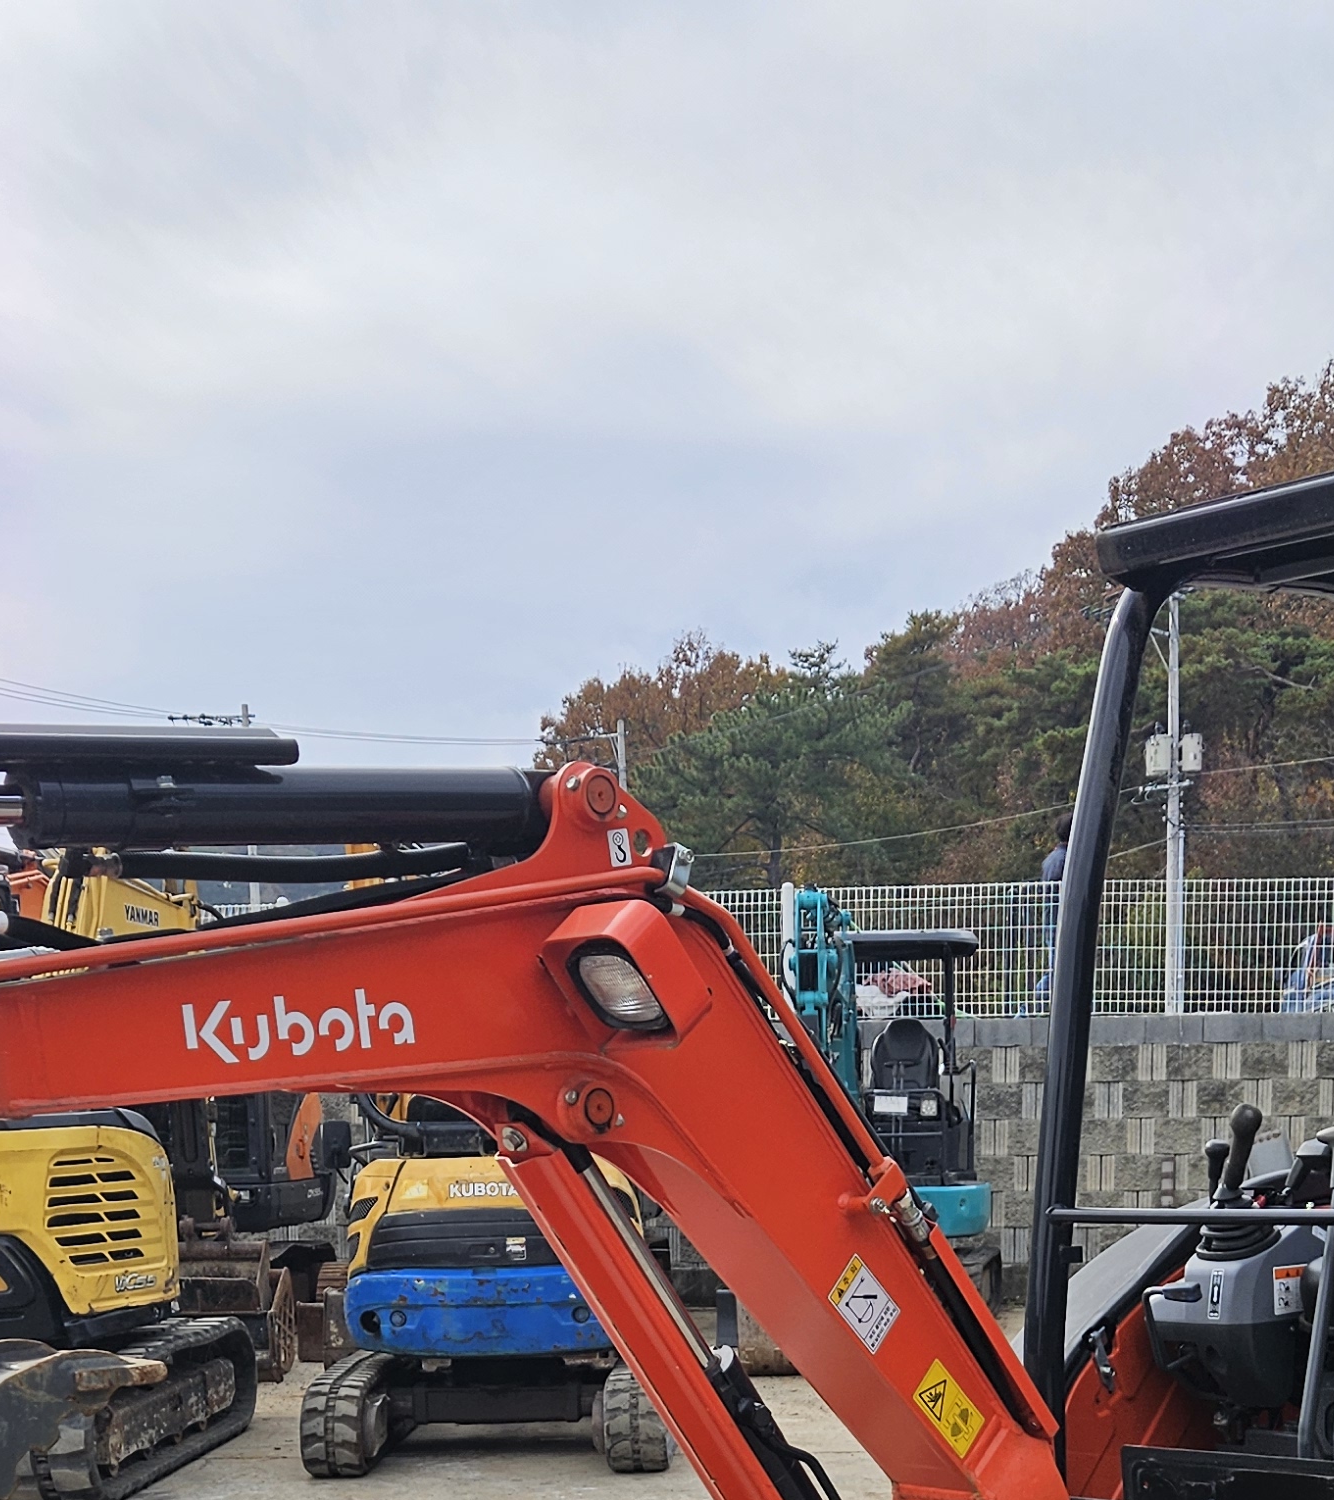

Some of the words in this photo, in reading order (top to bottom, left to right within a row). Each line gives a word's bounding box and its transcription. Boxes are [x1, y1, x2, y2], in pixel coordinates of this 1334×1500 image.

[124, 904, 159, 927] YANMAR
[182, 988, 415, 1063] Kubota
[449, 1181, 519, 1198] KUBOTA
